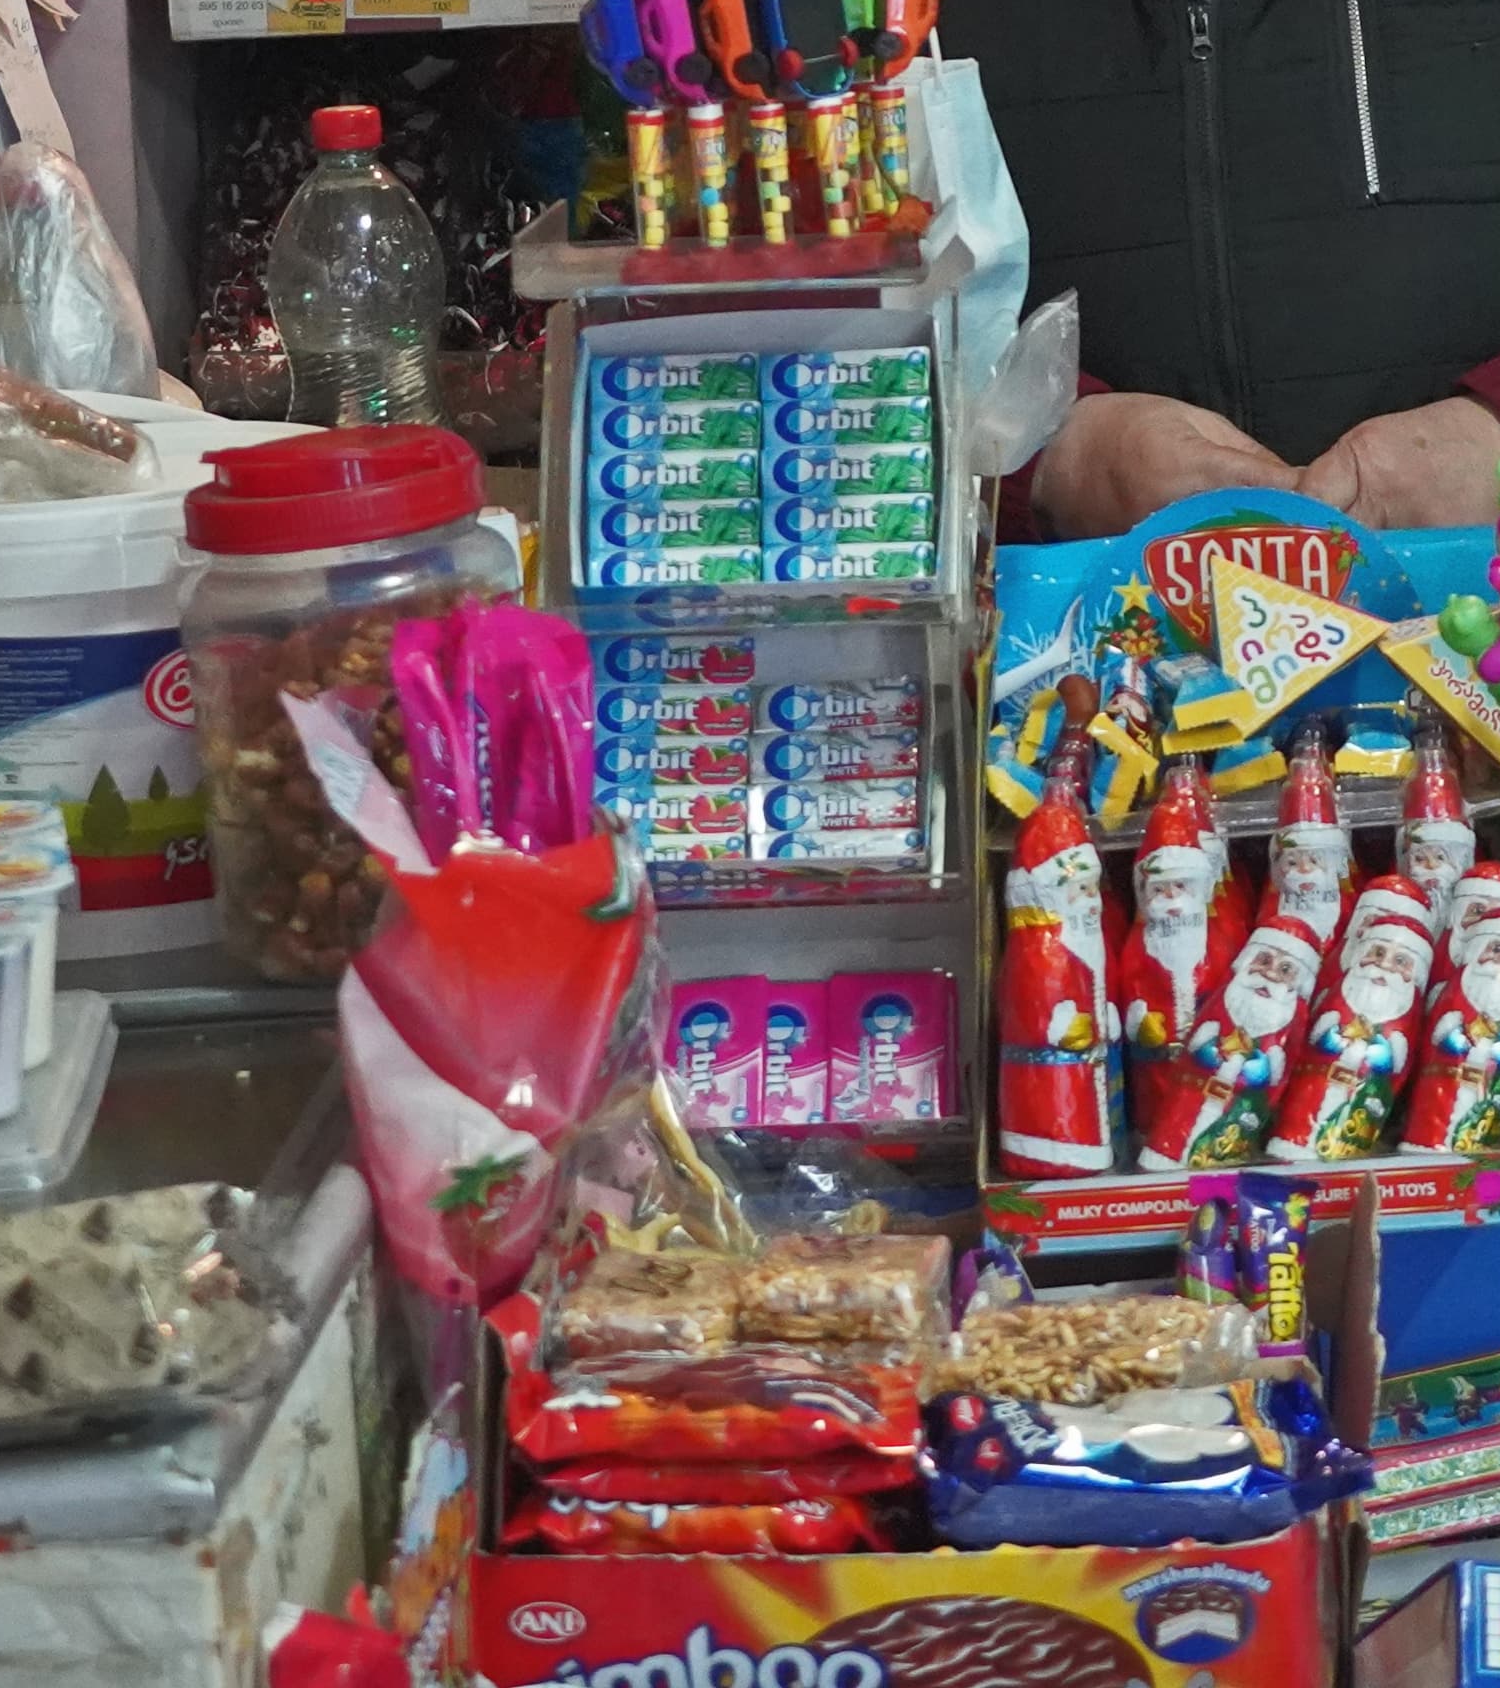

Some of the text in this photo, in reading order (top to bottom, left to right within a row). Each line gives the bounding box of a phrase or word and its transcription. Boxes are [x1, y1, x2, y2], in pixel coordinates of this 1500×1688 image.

[601, 357, 702, 403] Orbit
[772, 354, 874, 396] Orbit
[601, 404, 702, 448] Orbit
[774, 400, 875, 444] Orbit
[601, 453, 702, 497] Orbit
[773, 448, 876, 493] Orbit
[601, 502, 702, 547] Orbit
[775, 497, 877, 541] Orbit
[1164, 534, 1333, 607] SANTA
[603, 637, 705, 684] Orbit
[596, 688, 712, 733] Orbit
[768, 684, 870, 731] Orbit
[595, 737, 710, 783] Orbit
[763, 734, 870, 780] Orbit
[1058, 1204, 1105, 1220] MILKY
[1108, 1197, 1202, 1218] COMPOUN
[1398, 1182, 1438, 1201] TOYS
[515, 1612, 576, 1637] ANI
